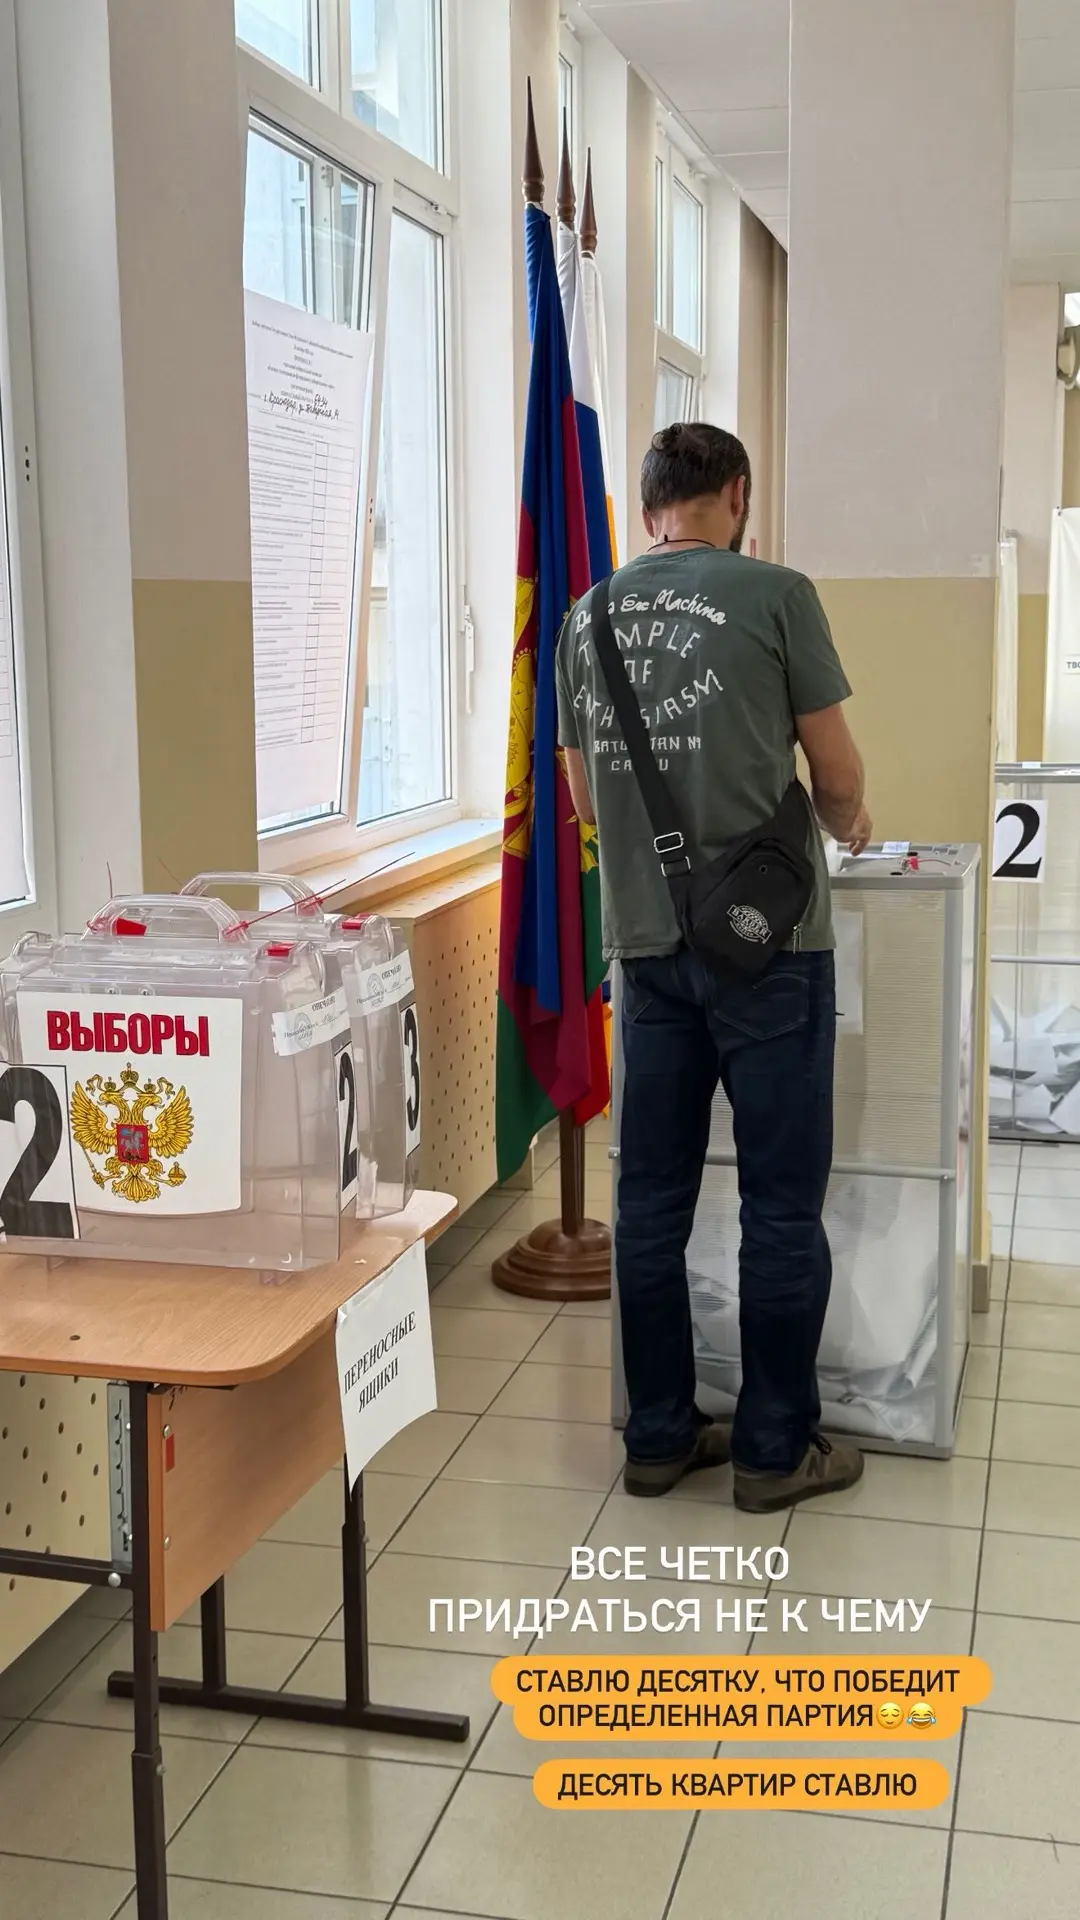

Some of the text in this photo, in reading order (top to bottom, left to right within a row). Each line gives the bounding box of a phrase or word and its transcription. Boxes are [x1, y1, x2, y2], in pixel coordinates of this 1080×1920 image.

[620, 593, 650, 613] Ex
[652, 588, 727, 626] Machina
[578, 620, 701, 666] TMPLE
[573, 668, 724, 729] ENTHSIASM
[611, 758, 669, 772] CAU
[992, 802, 1042, 879] 2
[46, 1011, 209, 1056] ВЫБОРЫ
[403, 1007, 421, 1132] 3
[338, 1051, 358, 1191] 2
[0, 1066, 75, 1239] 2
[344, 1311, 417, 1396] ПЕРЕНОСНЫЕ
[358, 1356, 400, 1414] ЯЩИКИ
